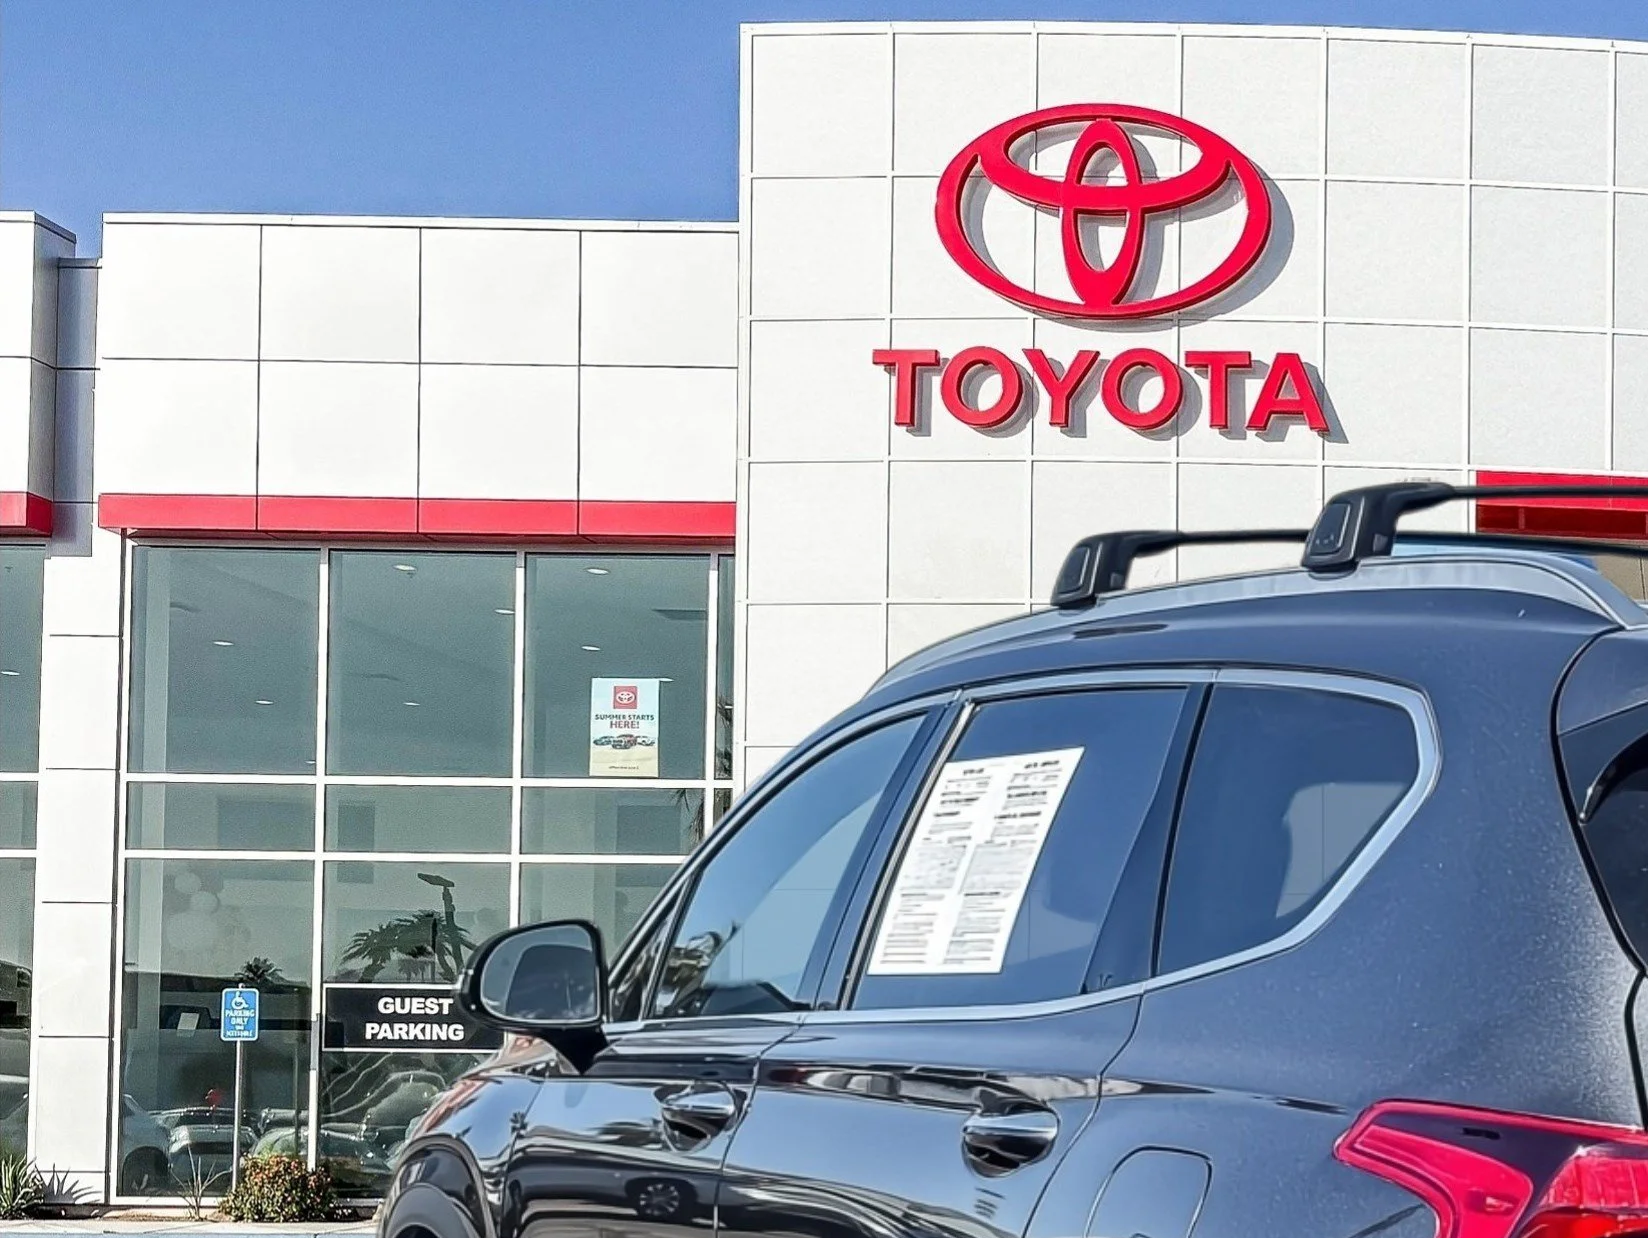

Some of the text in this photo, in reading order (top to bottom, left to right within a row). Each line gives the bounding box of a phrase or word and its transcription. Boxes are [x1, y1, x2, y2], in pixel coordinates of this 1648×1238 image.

[872, 346, 1330, 432] TOYOTA
[609, 721, 640, 729] HERE!
[225, 1009, 255, 1018] PARKING
[377, 996, 454, 1015] GUEST
[365, 1022, 465, 1041] PARKING
